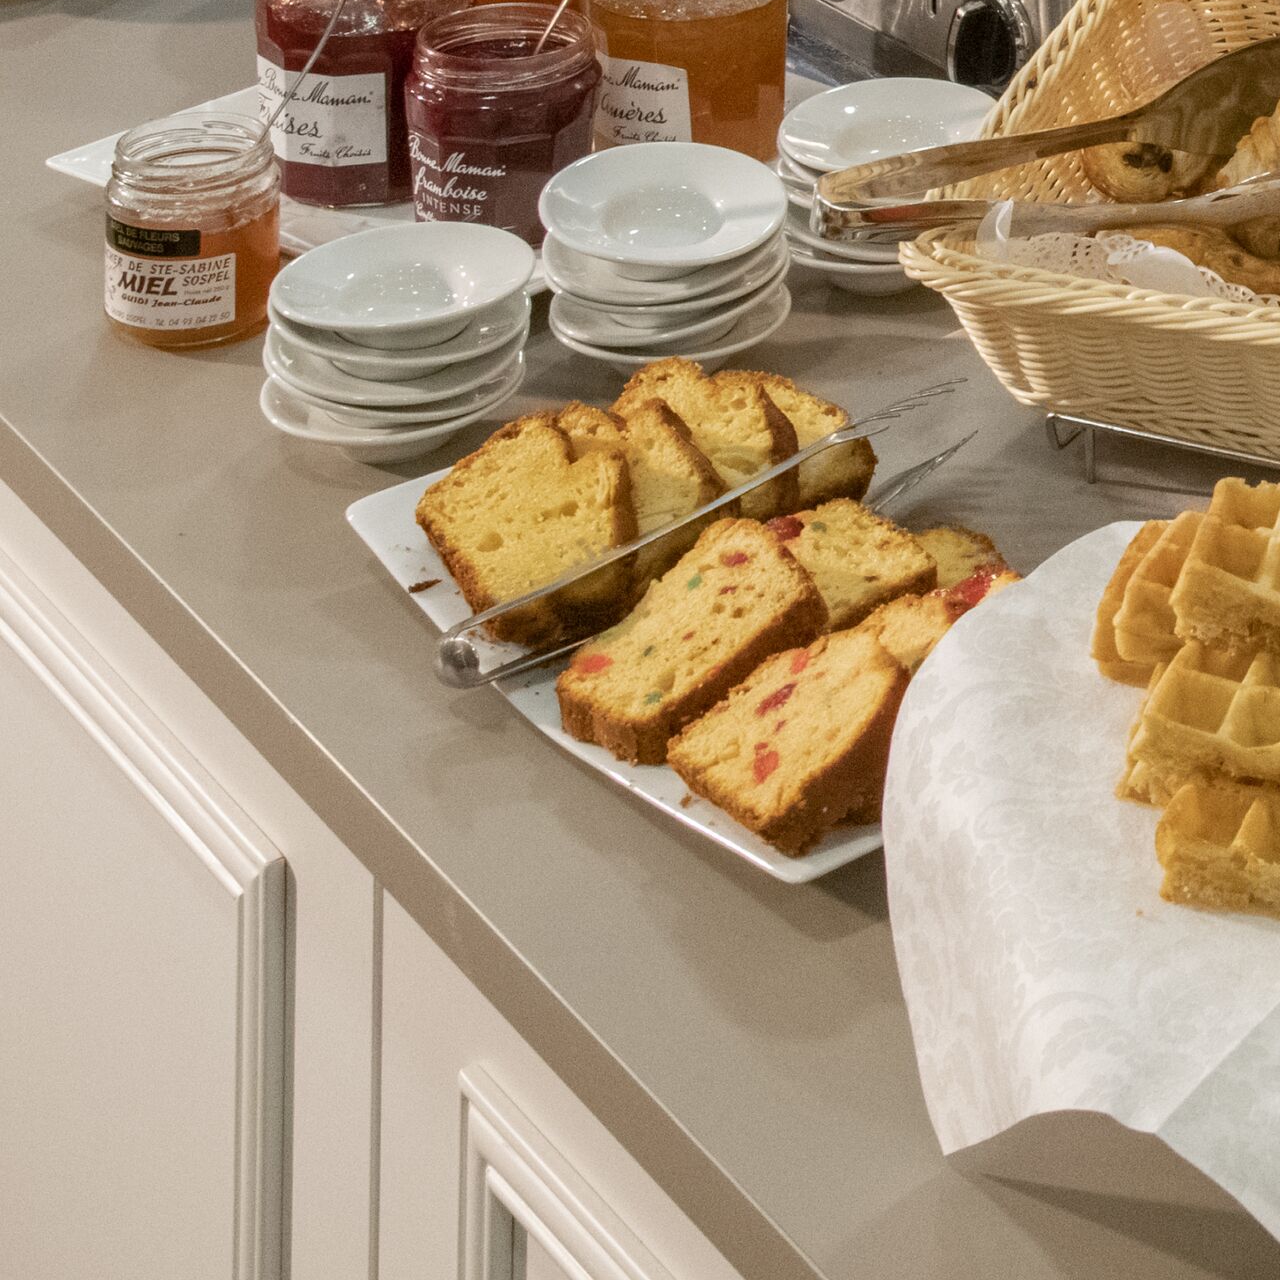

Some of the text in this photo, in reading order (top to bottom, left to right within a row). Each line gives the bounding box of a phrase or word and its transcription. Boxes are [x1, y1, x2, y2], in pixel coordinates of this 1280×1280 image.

[441, 152, 504, 177] Maman
[422, 193, 481, 216] INTENSE
[129, 257, 231, 275] DE STE-SABINE
[117, 271, 178, 296] MIEL
[182, 271, 230, 287] SOSPEL
[151, 296, 222, 308] Jean-Claude
